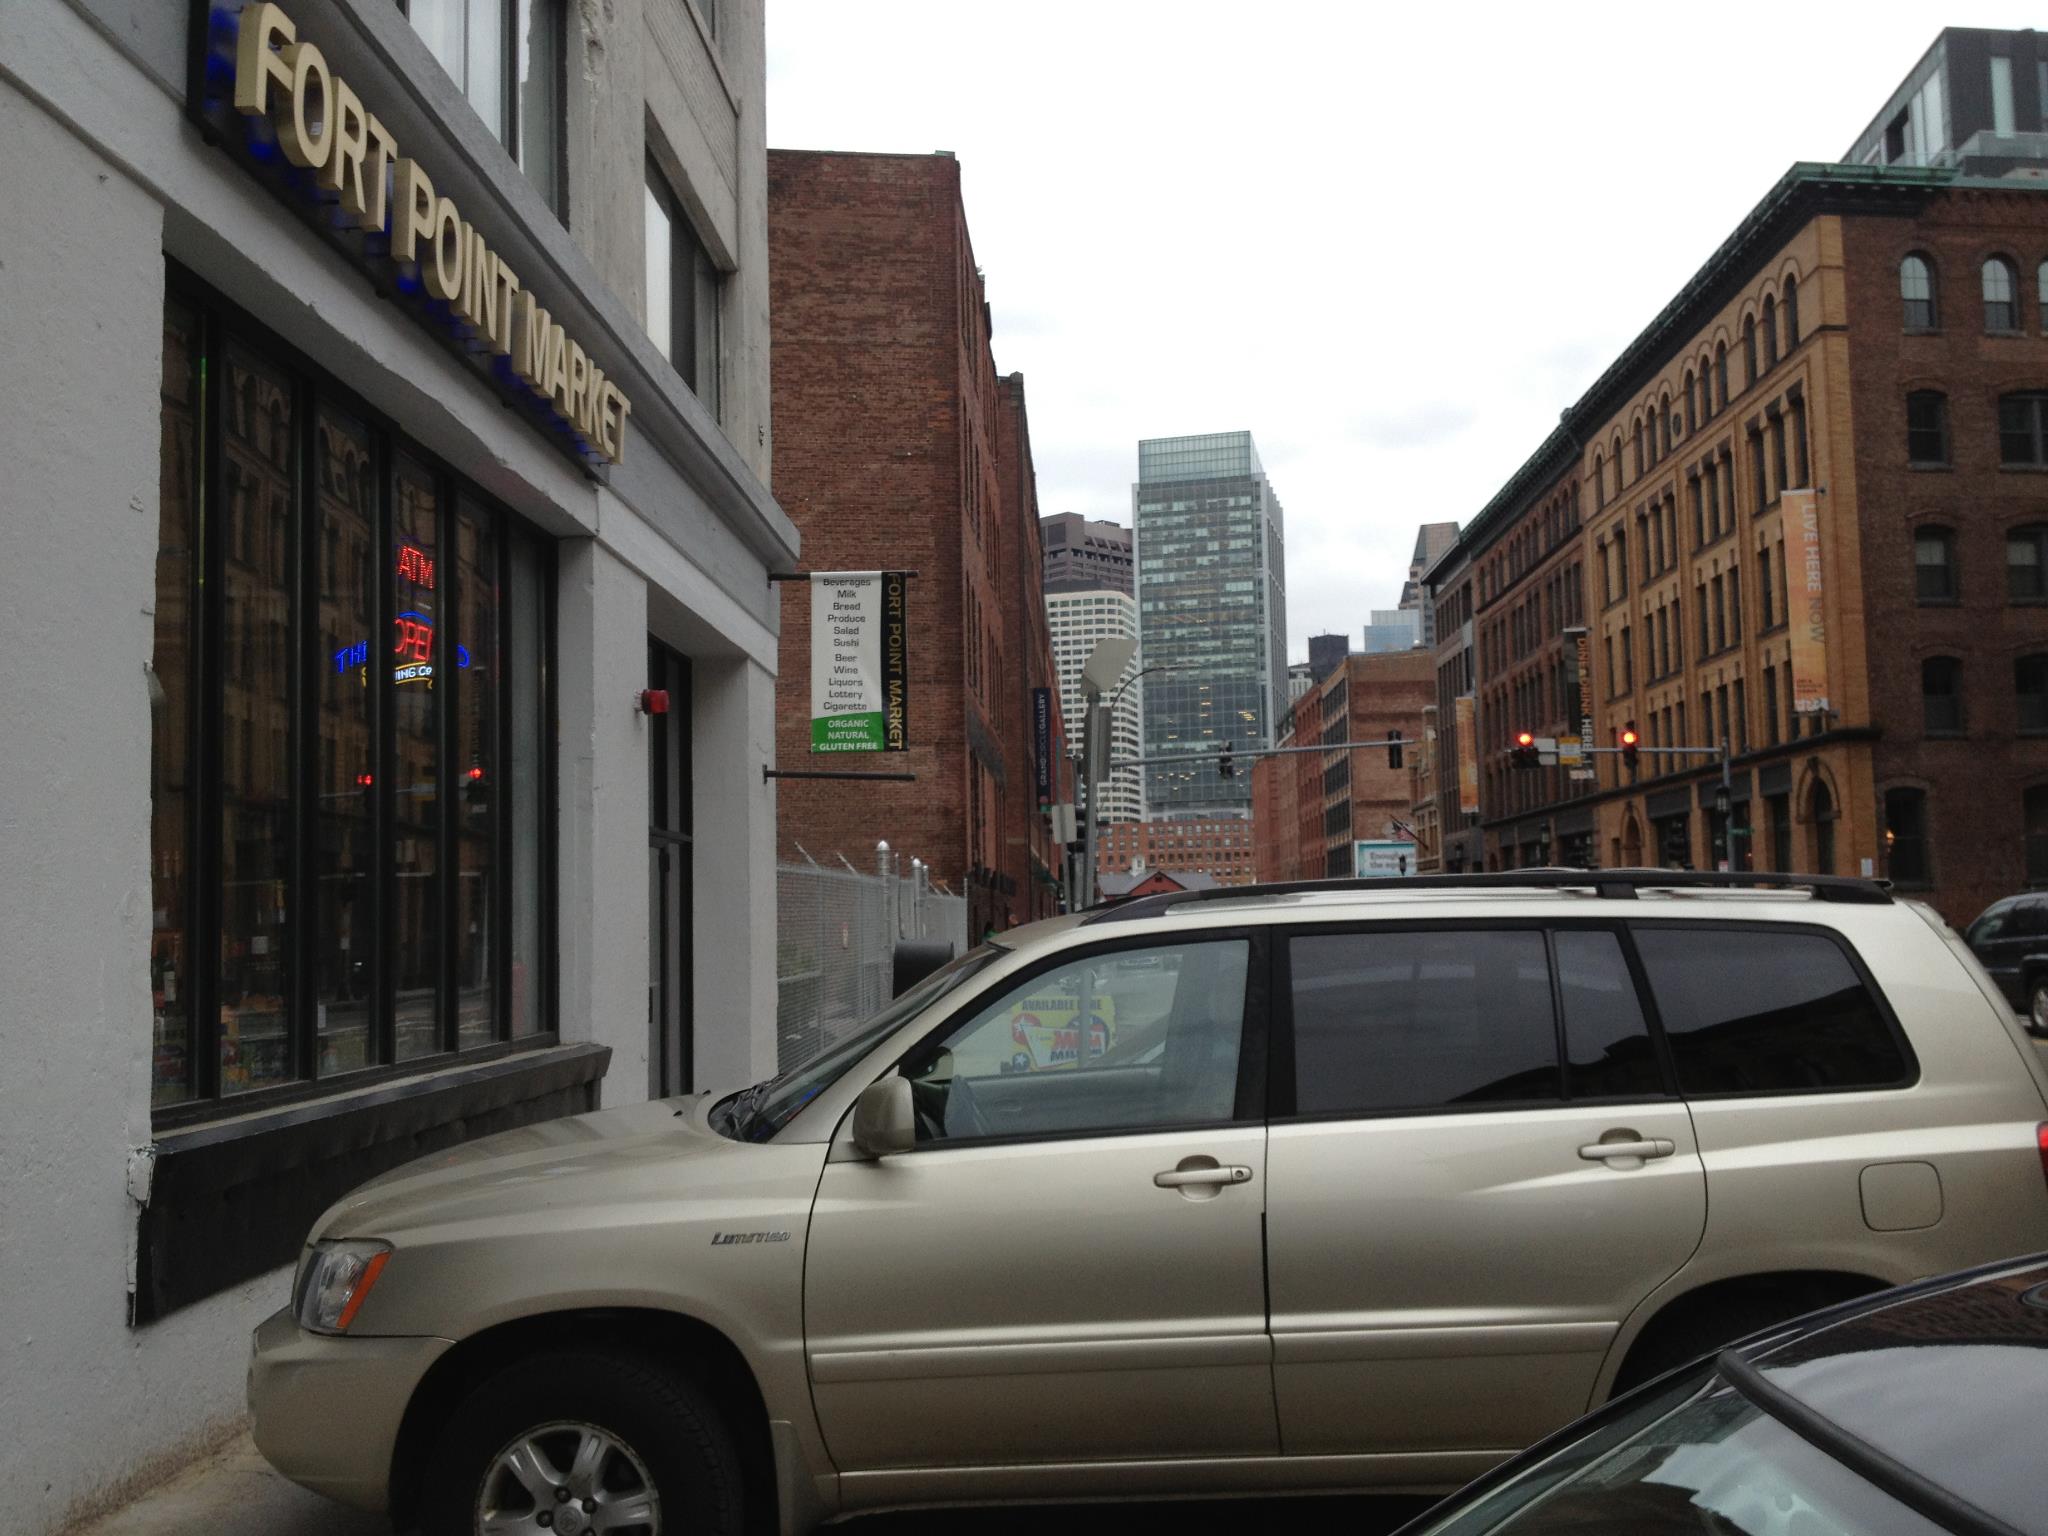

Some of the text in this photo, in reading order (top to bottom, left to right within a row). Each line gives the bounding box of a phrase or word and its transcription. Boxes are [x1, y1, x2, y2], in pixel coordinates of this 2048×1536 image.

[235, 2, 631, 466] FORT POINT MARKET
[398, 545, 433, 589] ATM
[1802, 503, 1824, 644] LIVE HERE NOW
[823, 578, 871, 588] Beverages
[837, 590, 857, 598] Milk
[833, 602, 861, 611] Bread
[827, 614, 866, 623] Produce
[833, 626, 860, 635] Salad
[833, 638, 860, 647] Sushi
[835, 654, 858, 662] Beer
[888, 572, 903, 750] FORT POINT MARKET
[834, 666, 858, 674] Wine
[829, 678, 863, 688] Liquors
[829, 690, 863, 699] Lottery
[823, 701, 867, 712] Cigarette
[828, 719, 870, 728] ORGANIC
[828, 731, 870, 740] NATURAL
[1581, 718, 1593, 751] HERE
[819, 742, 878, 751] GLUTEN FREE
[1022, 999, 1073, 1011] AVAILABLE
